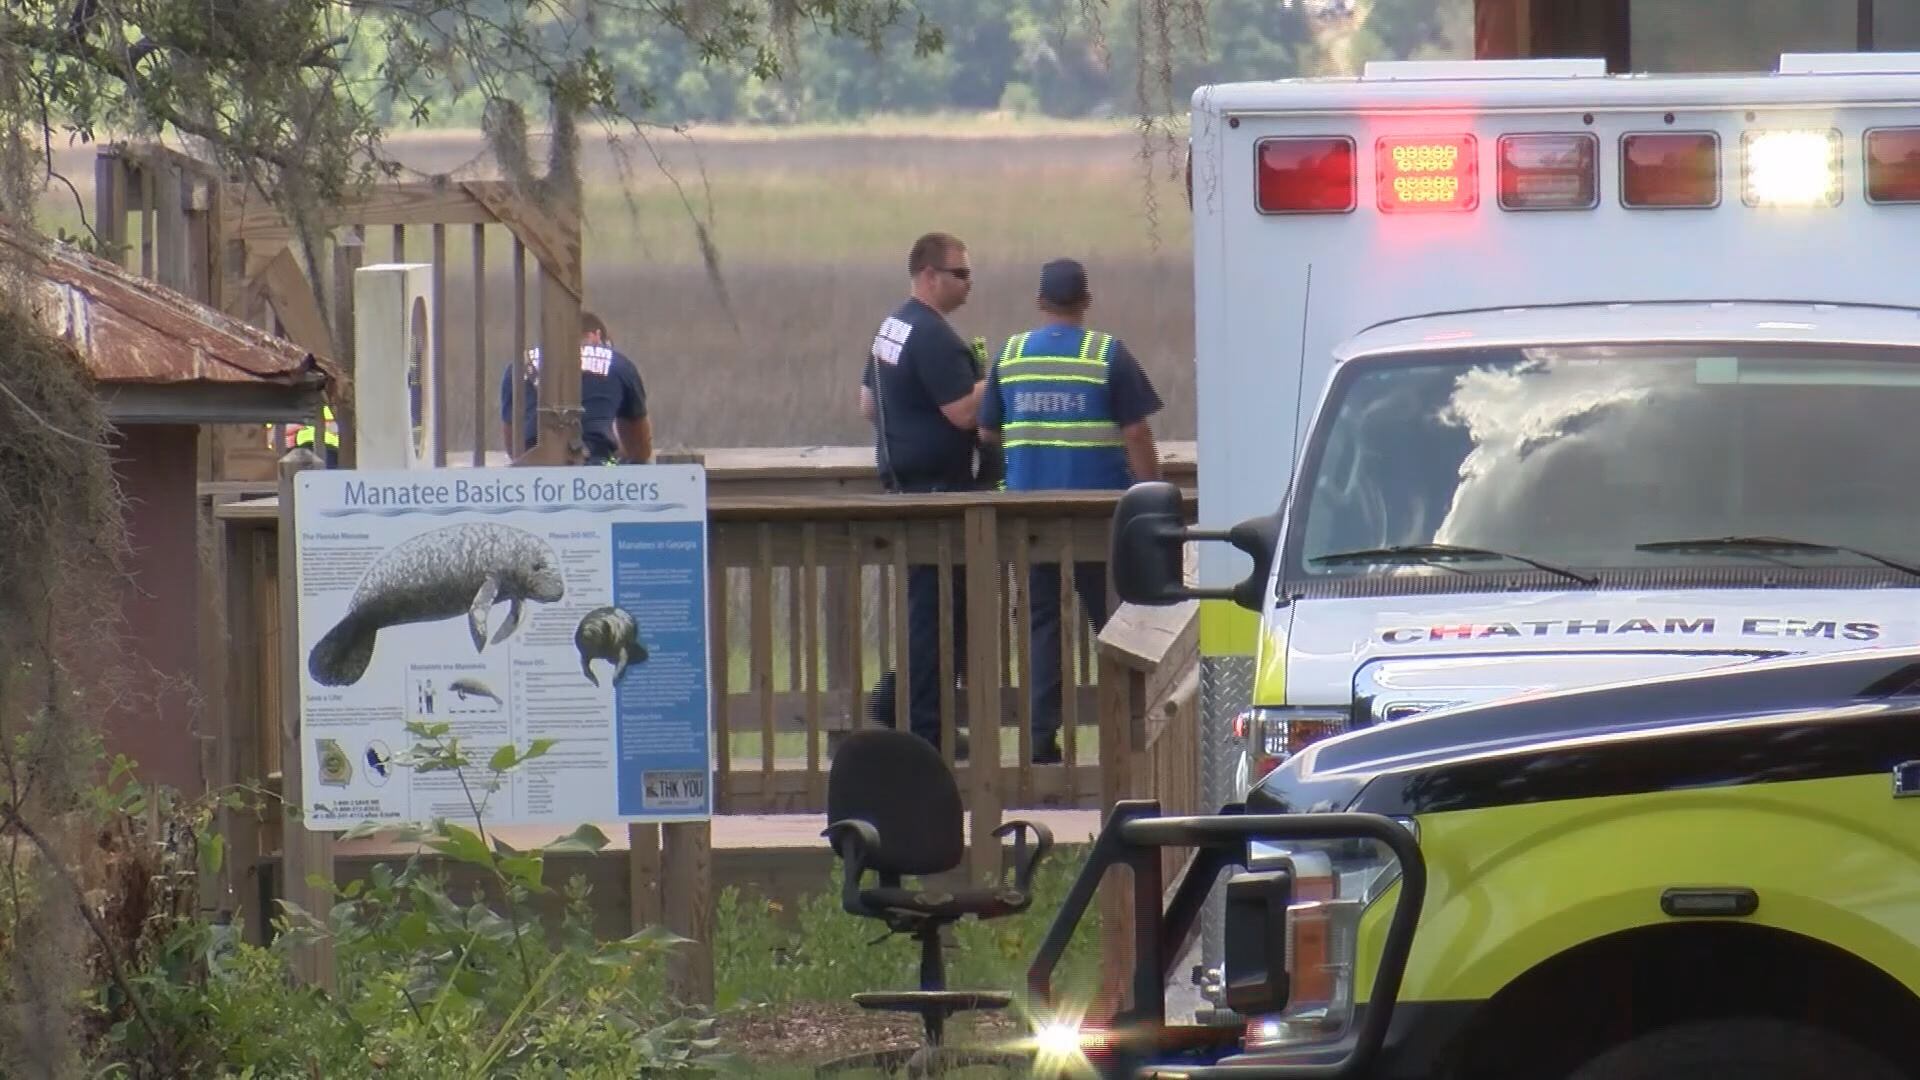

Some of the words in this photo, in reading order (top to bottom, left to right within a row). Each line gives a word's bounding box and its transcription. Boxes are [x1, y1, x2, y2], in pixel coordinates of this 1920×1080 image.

[1014, 392, 1087, 412] SAFETY-1
[344, 480, 449, 504] Manatee
[455, 478, 525, 503] Basics
[533, 476, 565, 502] for
[572, 477, 659, 501] Boaters
[1381, 617, 1716, 644] CHATHAM
[1741, 618, 1880, 641] EMS
[660, 780, 679, 797] THK
[683, 780, 703, 797] YOU
